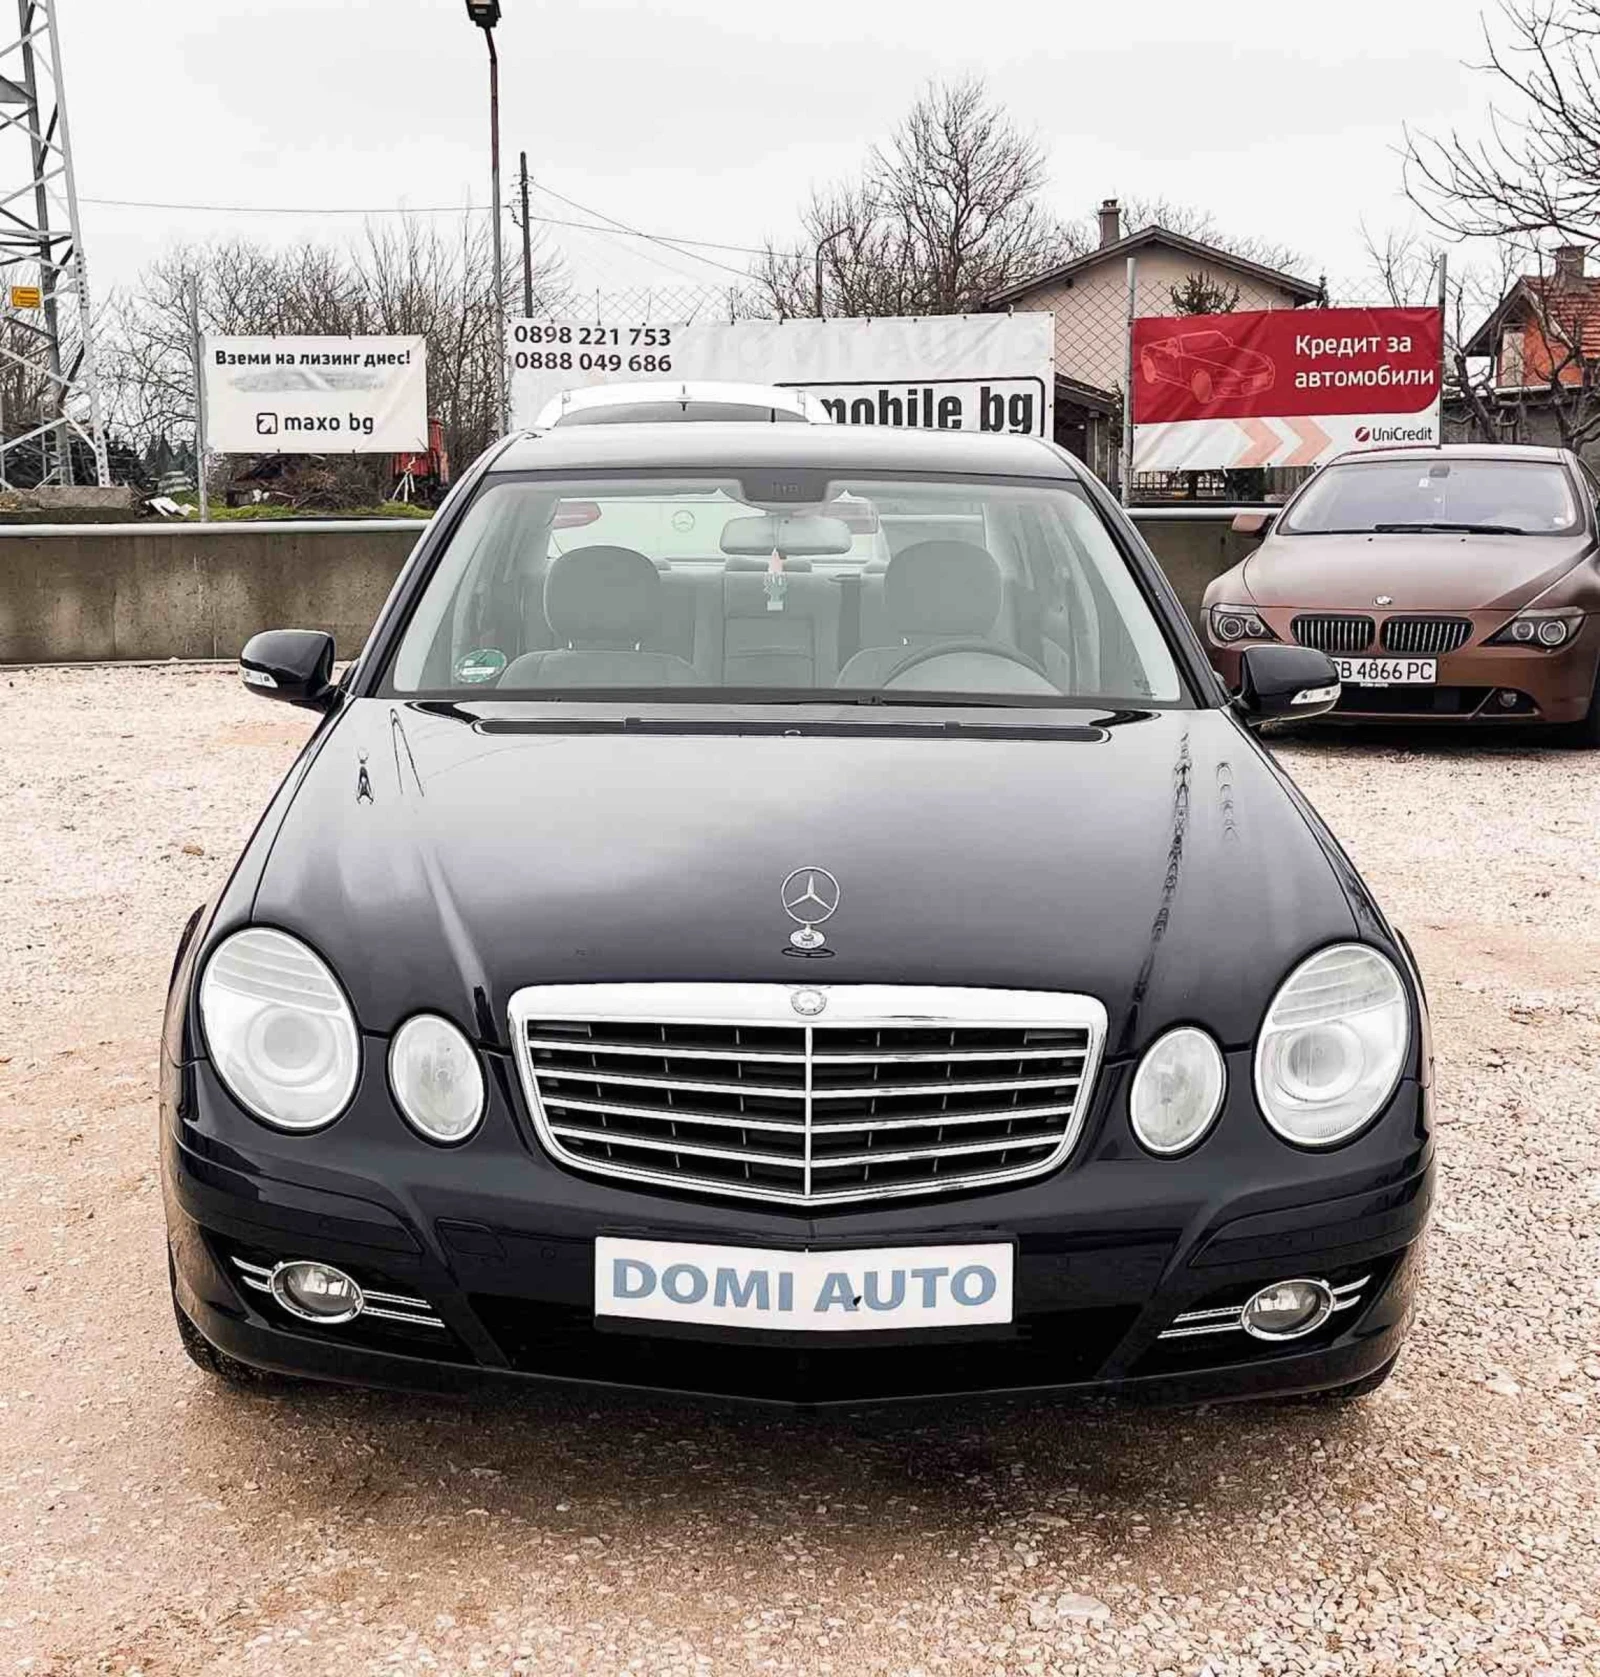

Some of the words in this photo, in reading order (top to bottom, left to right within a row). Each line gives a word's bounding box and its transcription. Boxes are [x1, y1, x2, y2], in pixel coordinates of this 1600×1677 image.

[514, 325, 572, 344] 0898
[579, 328, 619, 346] 221
[629, 328, 671, 347] 753
[1296, 335, 1381, 358] Кредит
[1387, 336, 1412, 352] за
[215, 350, 271, 365] Вземи
[276, 353, 295, 365] на
[299, 353, 360, 365] лизинг
[364, 350, 411, 368] днес!
[515, 352, 572, 370] 0888
[579, 354, 621, 372] 049
[628, 355, 672, 373] 686
[1295, 366, 1434, 388] автомобили
[980, 386, 1033, 434] bg
[284, 415, 340, 431] maxo
[349, 413, 374, 434] bg
[1372, 426, 1432, 442] UniCredit
[1357, 662, 1403, 680] 4866
[1407, 662, 1433, 680] PC
[612, 1258, 794, 1312] DOMI
[813, 1264, 998, 1313] AUTO
